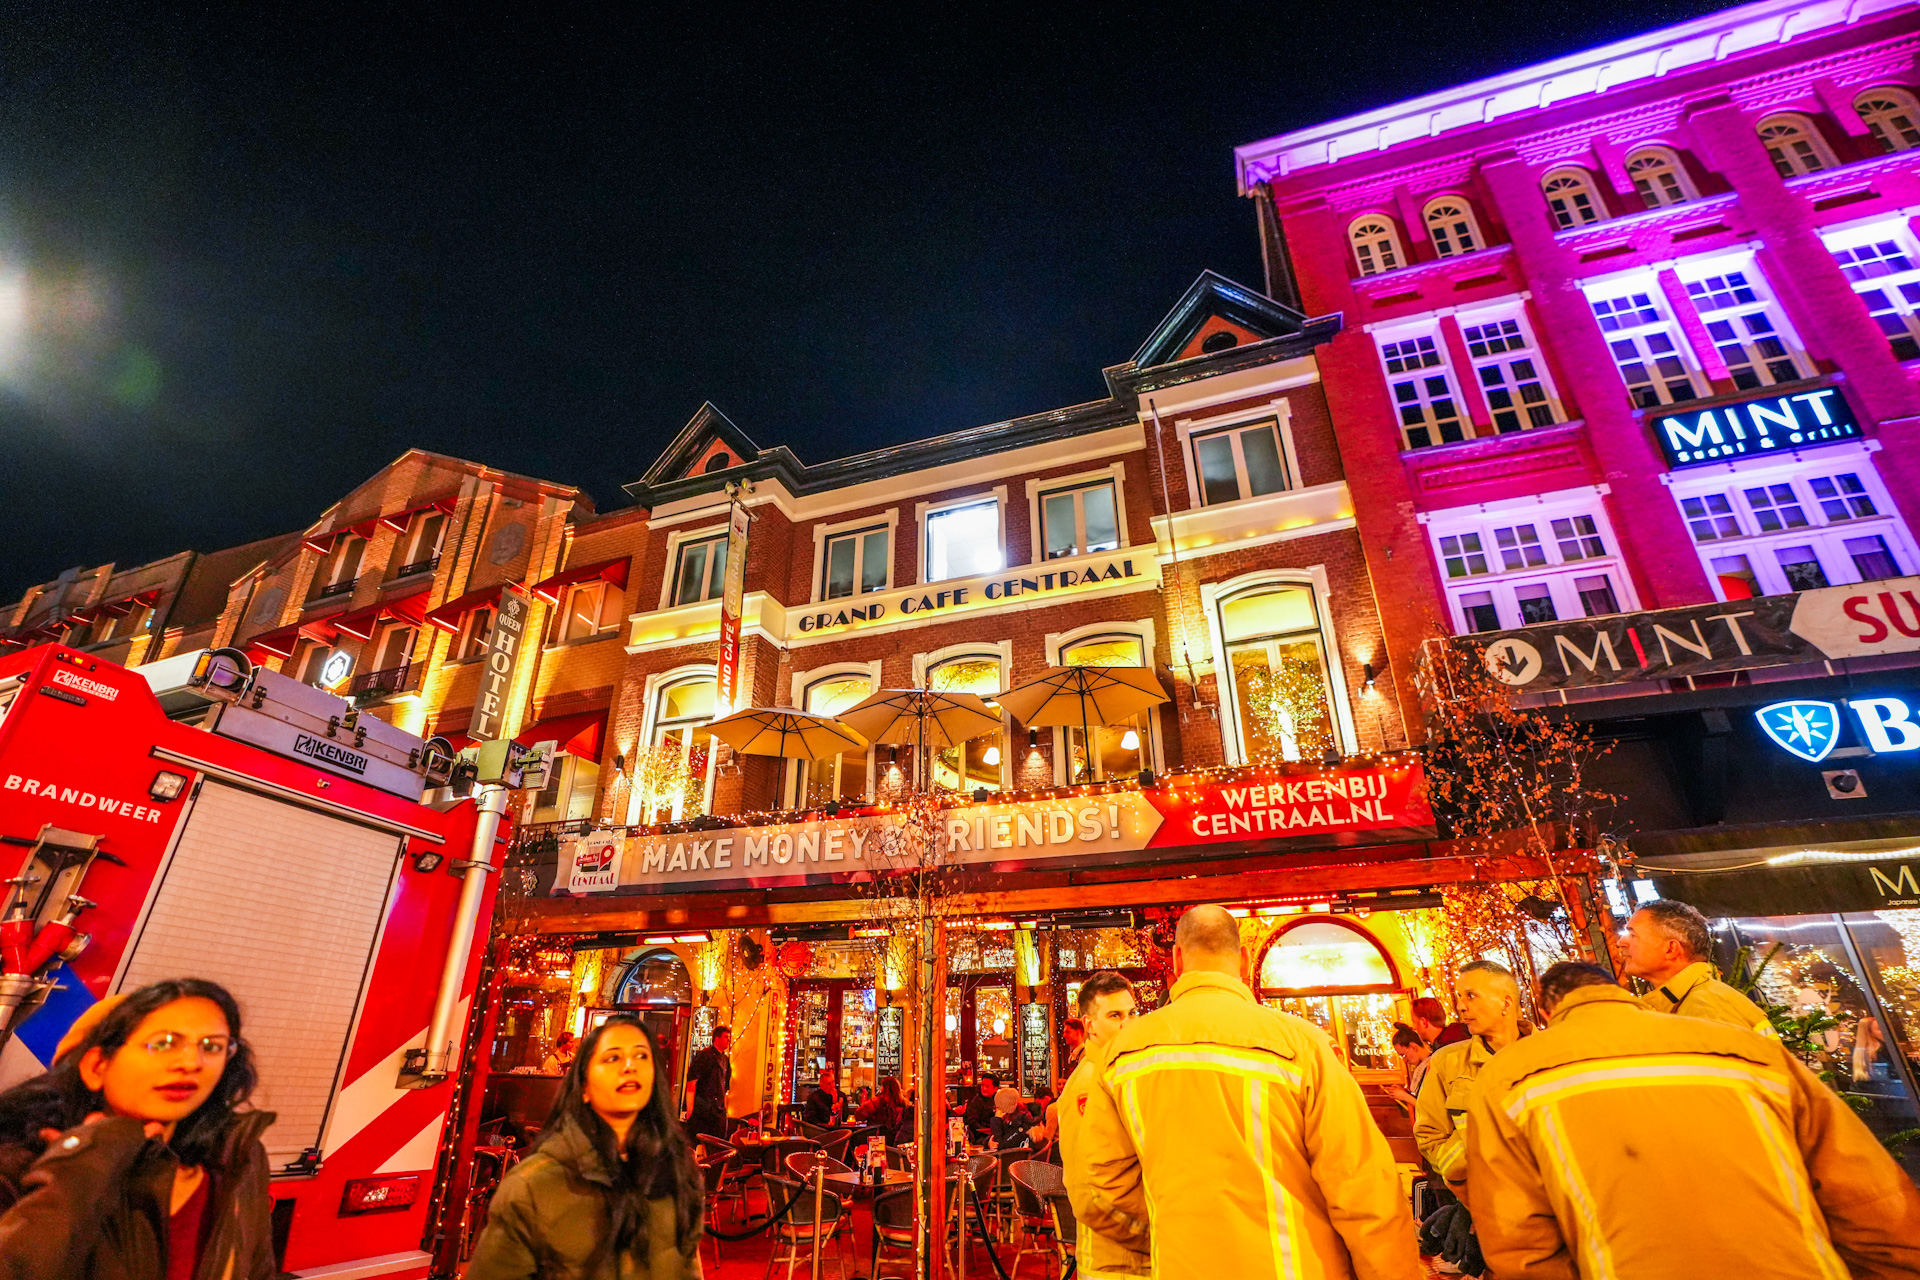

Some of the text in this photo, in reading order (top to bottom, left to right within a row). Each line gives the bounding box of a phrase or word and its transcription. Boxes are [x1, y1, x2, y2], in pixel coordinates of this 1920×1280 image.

[1662, 389, 1834, 450] MINT
[1677, 441, 1746, 462] Sushi
[1760, 437, 1775, 448] &
[727, 546, 741, 615] CENTRAAL
[798, 559, 1143, 633] GRAND CAFE CENTRAAL
[498, 612, 522, 633] QUEEN
[1553, 610, 1755, 677] MINT
[1842, 590, 1920, 644] SU
[71, 674, 119, 698] KENBRI
[476, 629, 517, 739] HOTEL
[720, 622, 736, 712] RAND CAFÉ
[1849, 697, 1920, 753] B
[315, 740, 369, 770] KENBRI
[3, 774, 162, 824] BRANDWEER
[1192, 799, 1394, 837] CENTRAAL.NL
[1220, 774, 1388, 811] WERKENBIJ
[641, 804, 1121, 874] MAKE MONEY & RIENDS!
[572, 872, 615, 887] CENTRAAL
[765, 992, 779, 1092] PHILIPS
[1354, 1045, 1391, 1056] CENTRA
